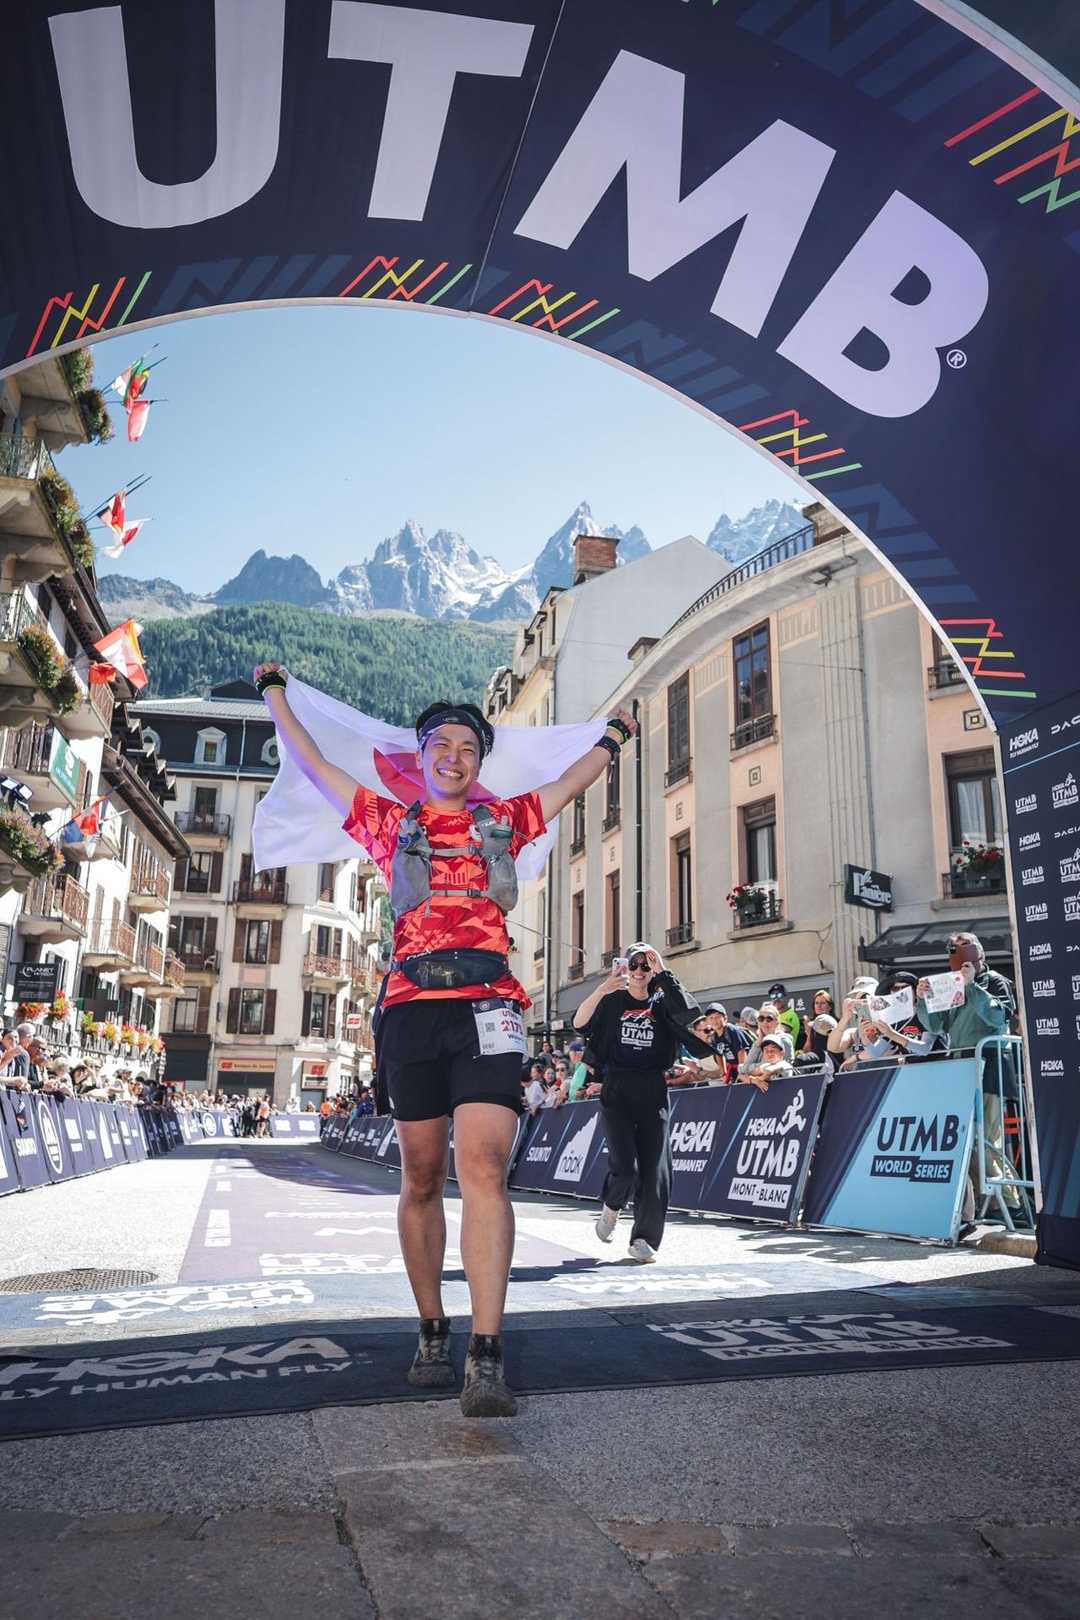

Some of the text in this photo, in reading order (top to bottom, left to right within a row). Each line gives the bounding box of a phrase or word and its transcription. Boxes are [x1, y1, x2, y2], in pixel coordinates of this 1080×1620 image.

[1009, 728, 1039, 751] HOKA
[1015, 794, 1037, 808] UTMB
[1052, 785, 1078, 802] UTMB
[1019, 832, 1041, 847] HOKA
[1022, 866, 1044, 880] UTMB
[1025, 903, 1048, 916] UTMB
[1029, 943, 1052, 956] HOKA
[1032, 979, 1056, 990] UTMB
[1036, 1018, 1060, 1029] UTMB
[621, 1027, 654, 1040] UTMB
[1040, 1060, 1064, 1071] HOKA
[745, 1118, 777, 1136] HOKA
[877, 1113, 960, 1152] UTMB
[670, 1121, 716, 1152] HOKA
[736, 1137, 801, 1177] UTMB
[874, 1160, 950, 1179] WORLD SERIES
[732, 1183, 788, 1203] MONT-BLANC
[646, 1319, 785, 1332] HOKA
[660, 1320, 960, 1347] UTMB
[722, 1337, 997, 1359] MONT-BLANC
[0, 1337, 353, 1385] HOKA
[70, 1368, 268, 1396] HUMAN
[279, 1361, 354, 1377] FLY
